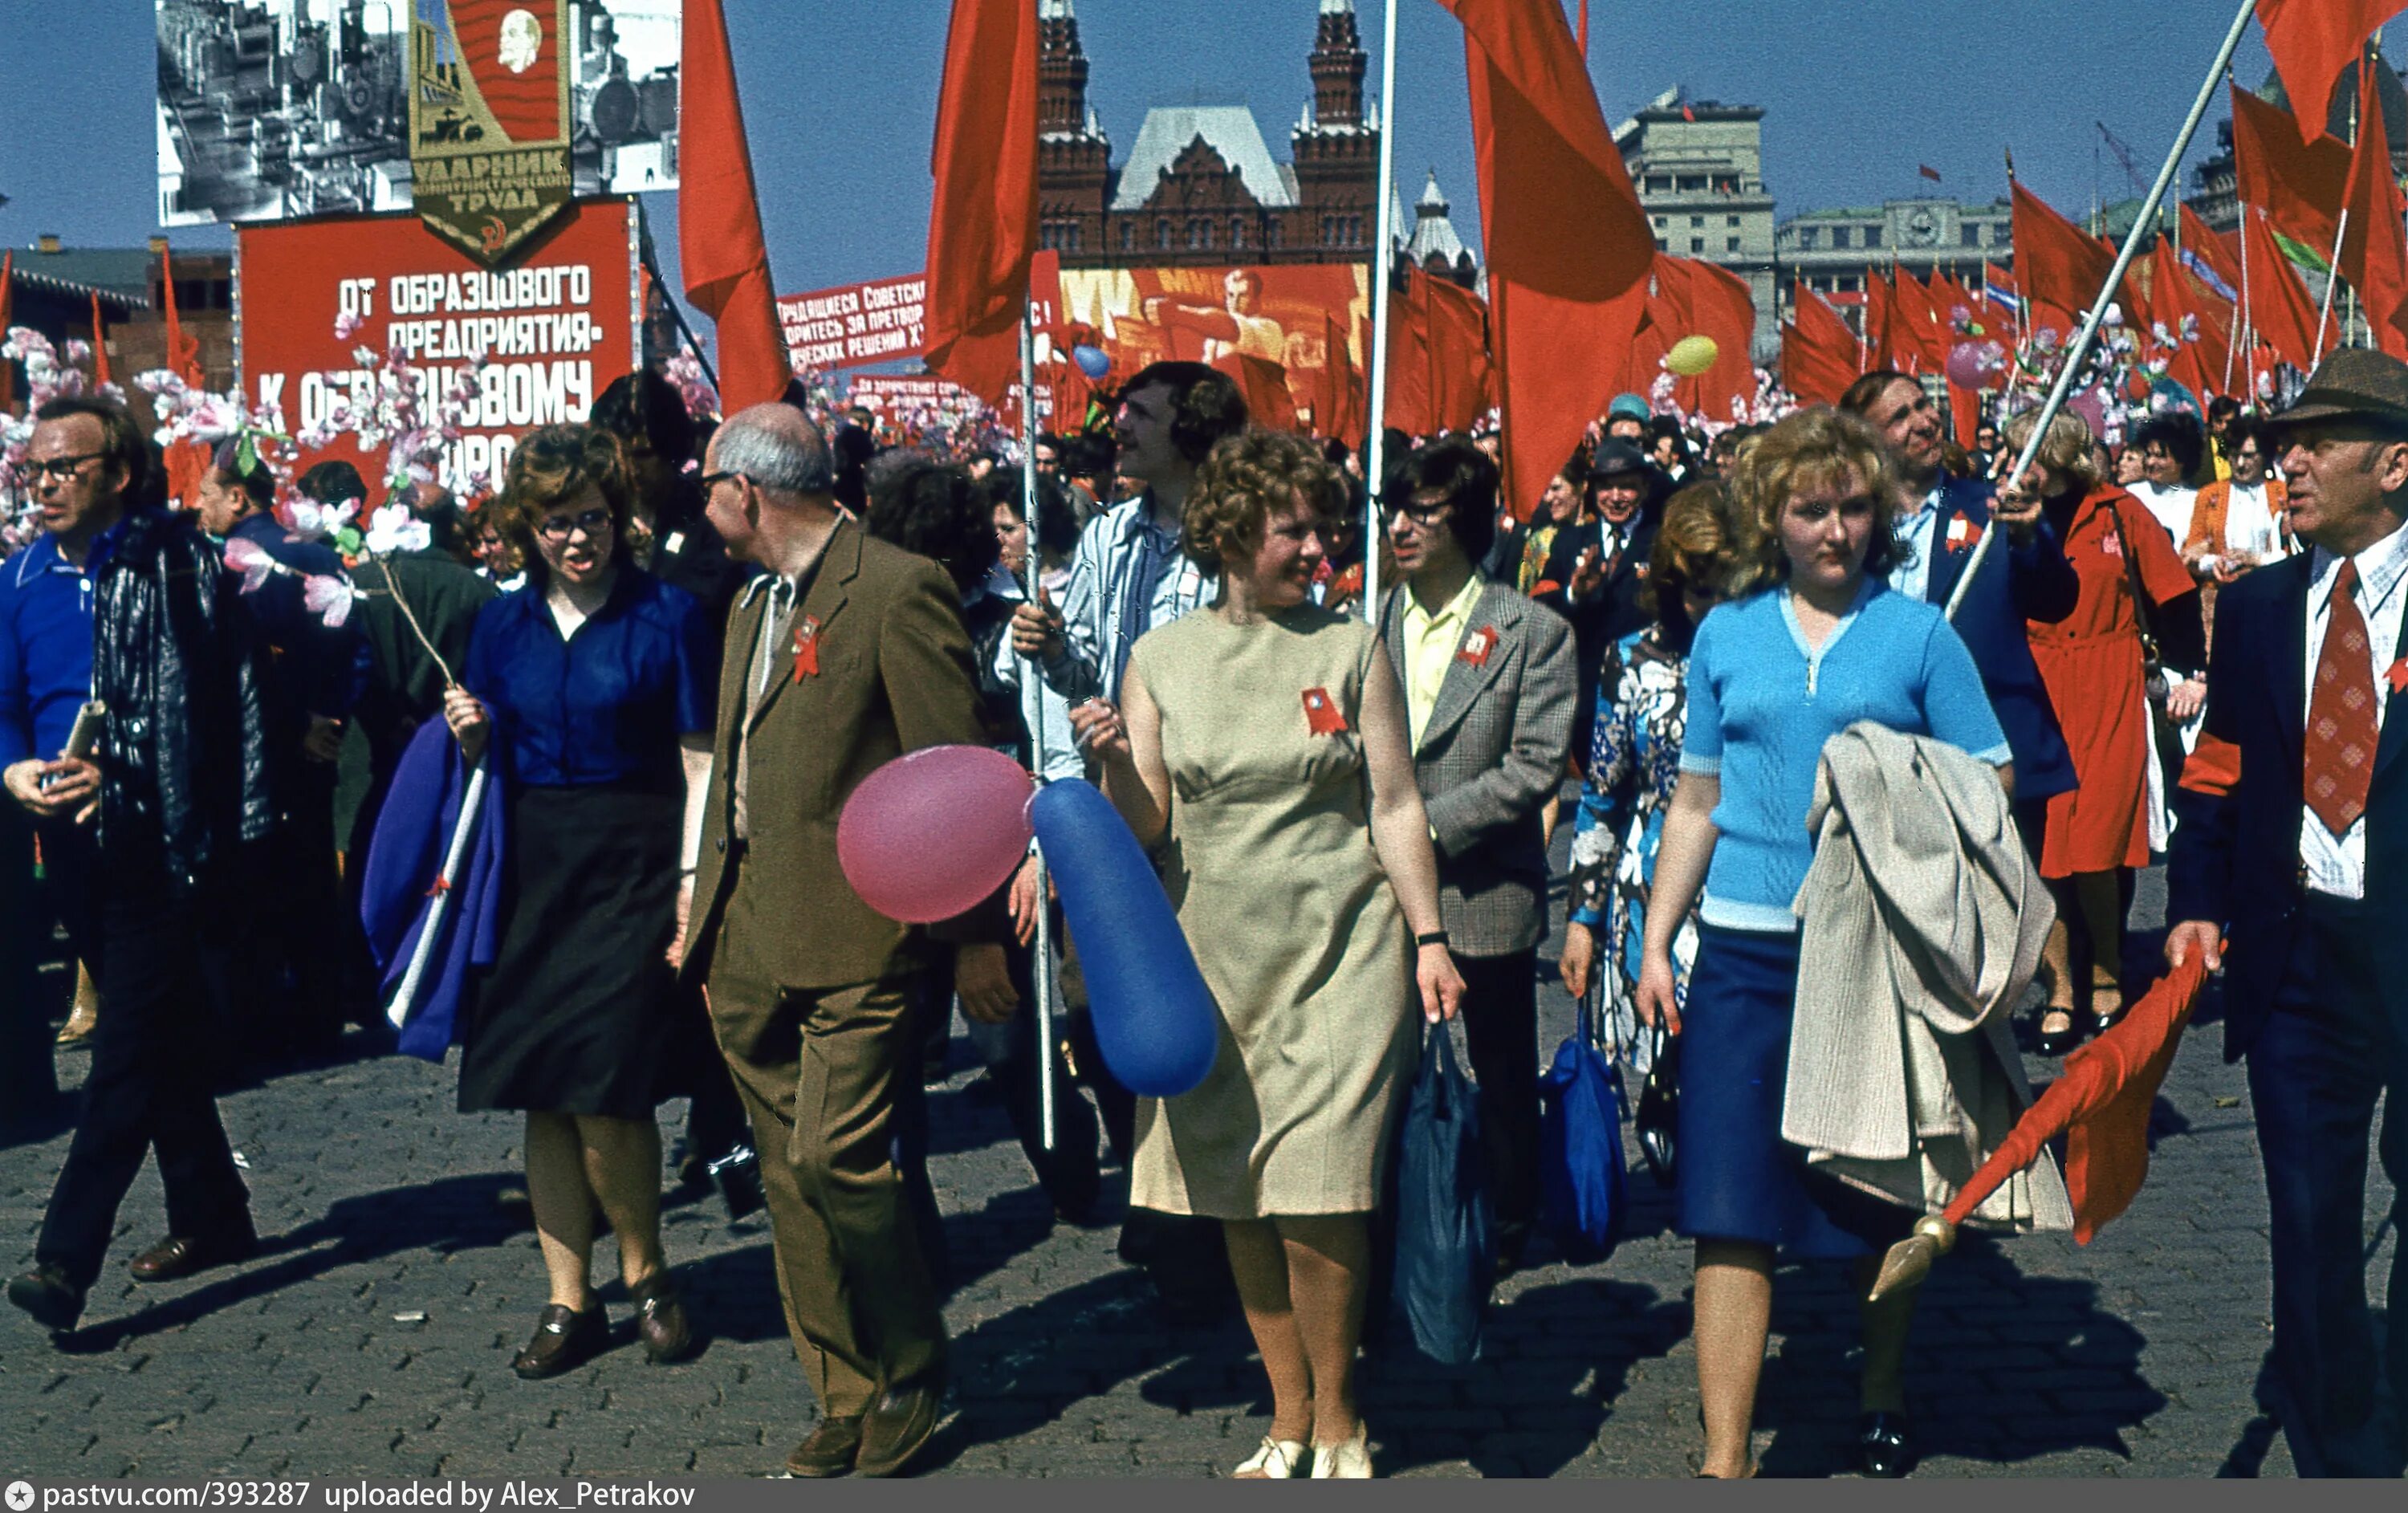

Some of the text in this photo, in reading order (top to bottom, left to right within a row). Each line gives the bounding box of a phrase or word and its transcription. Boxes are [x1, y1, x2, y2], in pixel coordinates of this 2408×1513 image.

[449, 189, 539, 214] ТРУДА
[338, 265, 591, 316] ОТ ОБРАЗЦОВОГО
[847, 314, 866, 335] ЗА
[848, 327, 906, 357] РЕШЕНИЙ
[258, 372, 287, 435] К
